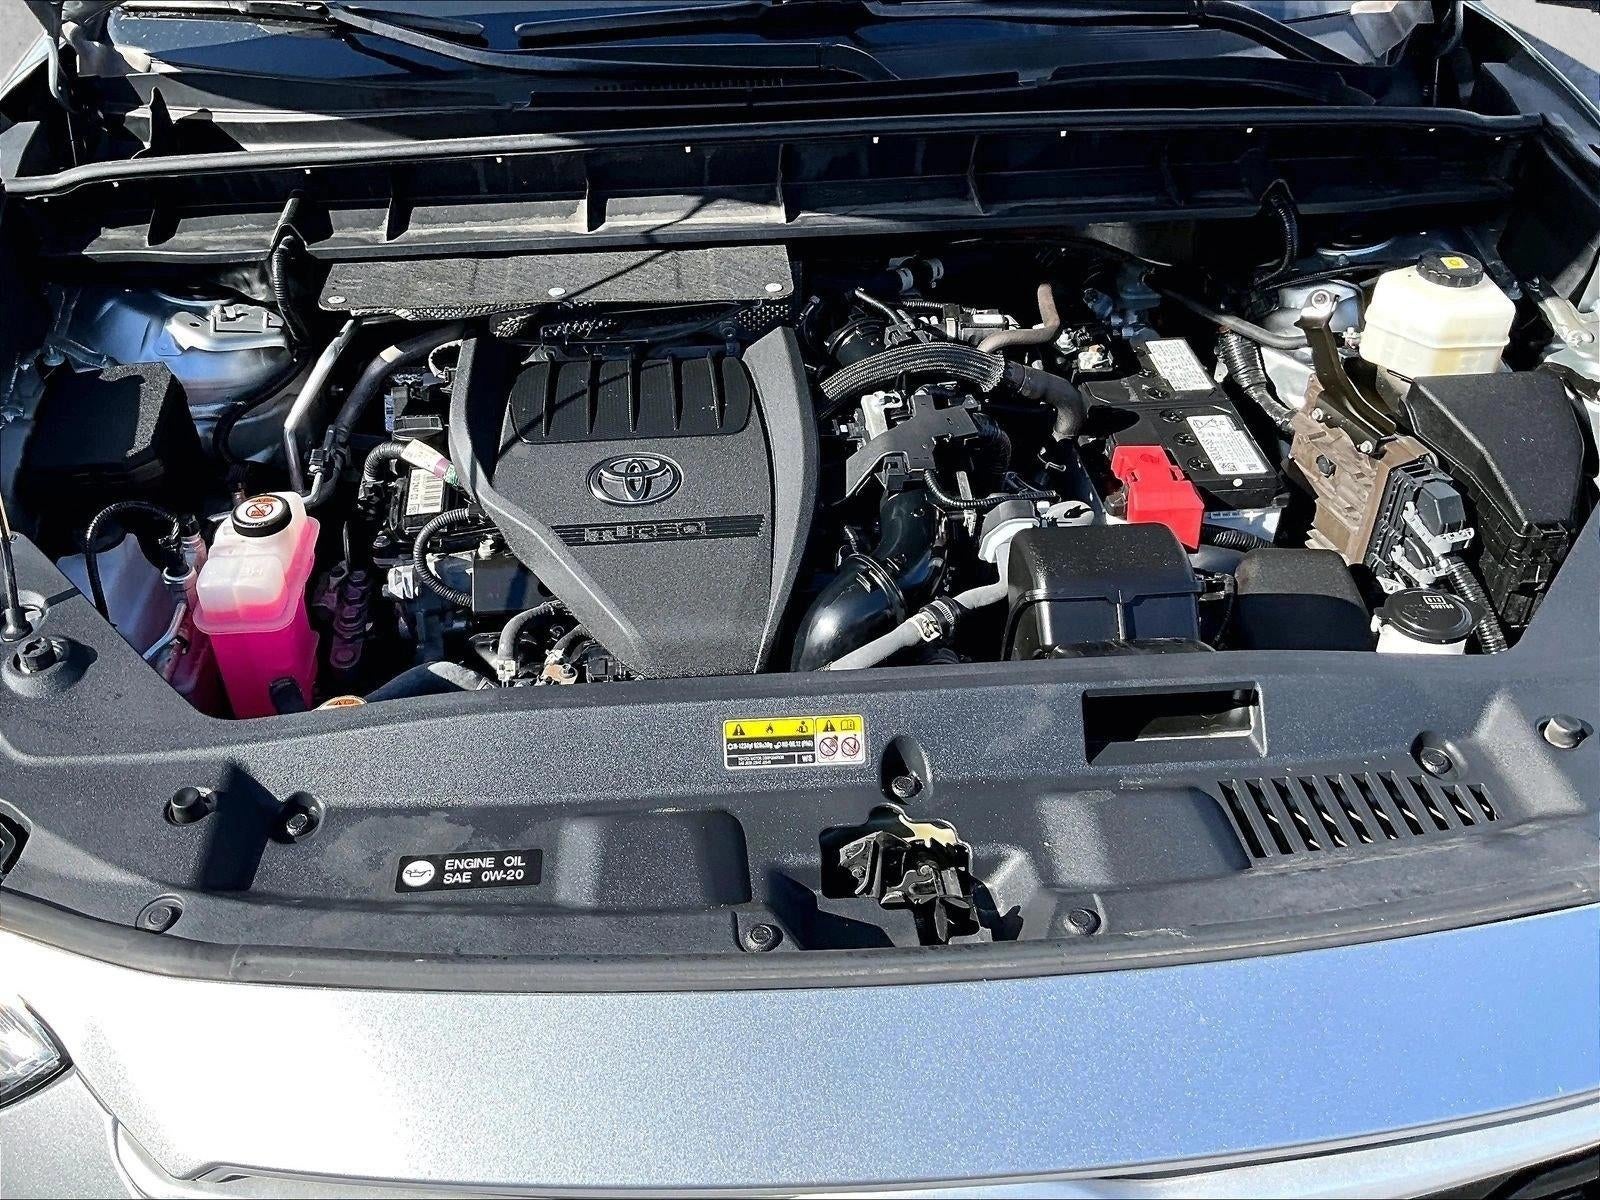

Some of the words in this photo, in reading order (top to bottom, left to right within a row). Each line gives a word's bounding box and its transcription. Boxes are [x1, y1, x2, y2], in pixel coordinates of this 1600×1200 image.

[586, 521, 705, 542] TURBO
[445, 857, 495, 870] ENGINE
[504, 856, 525, 867] OIL
[443, 871, 472, 884] SAE
[482, 869, 524, 882] 0W-20
